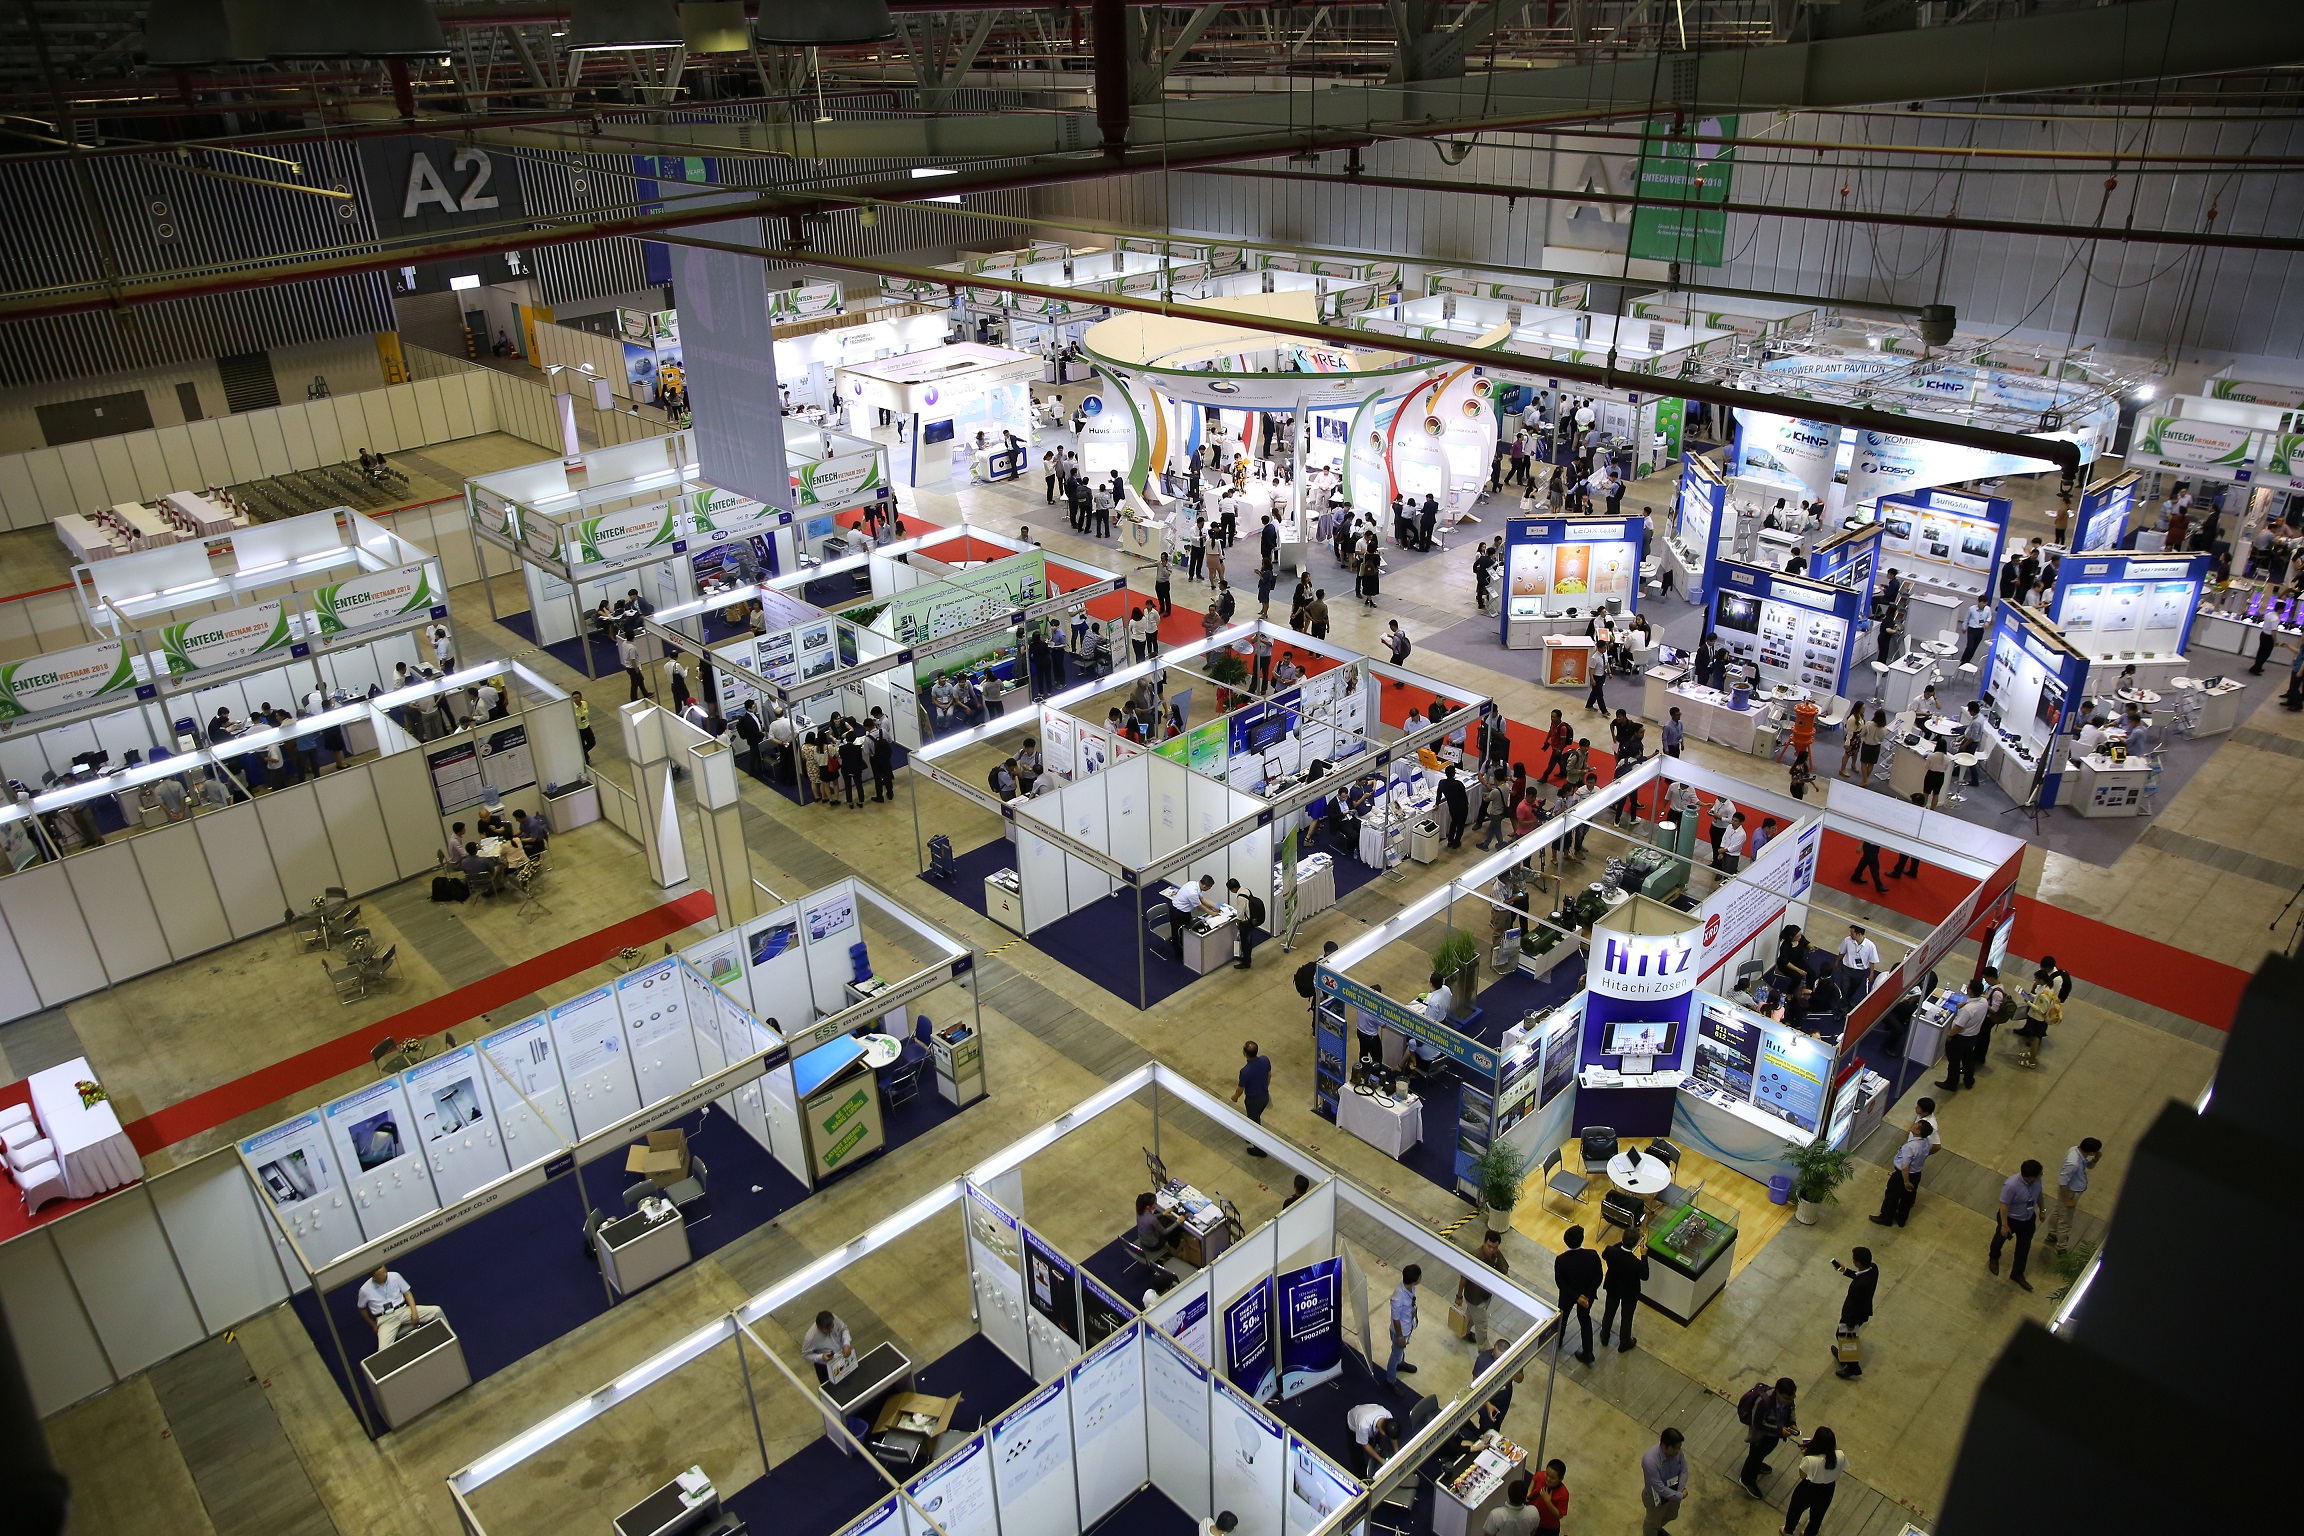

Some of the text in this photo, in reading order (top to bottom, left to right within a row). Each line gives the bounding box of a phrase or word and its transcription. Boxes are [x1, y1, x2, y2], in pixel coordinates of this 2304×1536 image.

[403, 148, 500, 218] A2
[1642, 312, 1660, 320] ENTECH
[1715, 322, 1735, 331] ENTECH
[1886, 344, 1914, 356] ENTECH
[1296, 349, 1349, 370] KOREA
[1983, 360, 2008, 370] ENTECH
[1788, 364, 1886, 374] POWER PLANT PAVILION
[2226, 392, 2257, 404] ENTECH
[1884, 434, 1926, 447] KOMIPO
[2162, 430, 2196, 442] ENTECH
[2195, 438, 2216, 447] VIETNAM
[812, 472, 838, 486] ENTECH
[708, 498, 736, 512] ENTECH
[1936, 498, 1969, 509] SUNGSAN
[594, 520, 658, 542] ENTECH VIETNAM 2018
[712, 531, 728, 540] SIM
[402, 566, 422, 574] KOREA
[334, 584, 411, 610] ENTECH VIETNAM 2018
[259, 602, 280, 612] KOREA
[183, 622, 268, 650] ENTECH VIETNAM 2018
[98, 642, 121, 652] KOREA
[12, 663, 109, 692] ENTECH VIETNAM 2018
[1180, 854, 1190, 863] CLEAN
[1207, 839, 1218, 848] GREEN
[1703, 925, 1719, 942] XRD
[1604, 938, 1692, 977] Hitz
[1601, 976, 1687, 994] Hitachi Zosen
[843, 976, 938, 1026] ESS VIET NAM ENERGY SAVING SOLUTIONS
[1342, 986, 1357, 1000] CÔNG
[1357, 994, 1364, 1003] TY
[1364, 998, 1378, 1011] TNHH
[1454, 1042, 1465, 1055] TKV
[1715, 1024, 1728, 1034] 911
[814, 1023, 838, 1041] ESS
[1380, 1014, 1412, 1035] ENVIRONMENT
[1412, 1031, 1436, 1048] COMPANY
[1436, 1042, 1455, 1056] LIMITED
[1714, 1030, 1727, 1041] 612
[1766, 1040, 1786, 1054] Hitz
[628, 1118, 651, 1132] XIAMEN
[651, 1104, 680, 1122] GUANLING
[715, 1082, 726, 1092] LTD
[825, 1124, 862, 1162] LATENT ENERGY
[836, 1136, 859, 1158] STORAGE
[383, 1237, 410, 1254] XIAMEN
[410, 1220, 444, 1242] GUANLING
[486, 1194, 498, 1204] LTD
[1240, 1304, 1258, 1322] WEBSITE
[1295, 1298, 1318, 1312] 1000
[1239, 1314, 1260, 1334] -50%
[1300, 1326, 1330, 1342] 19002069
[1242, 1346, 1266, 1368] 19002069
